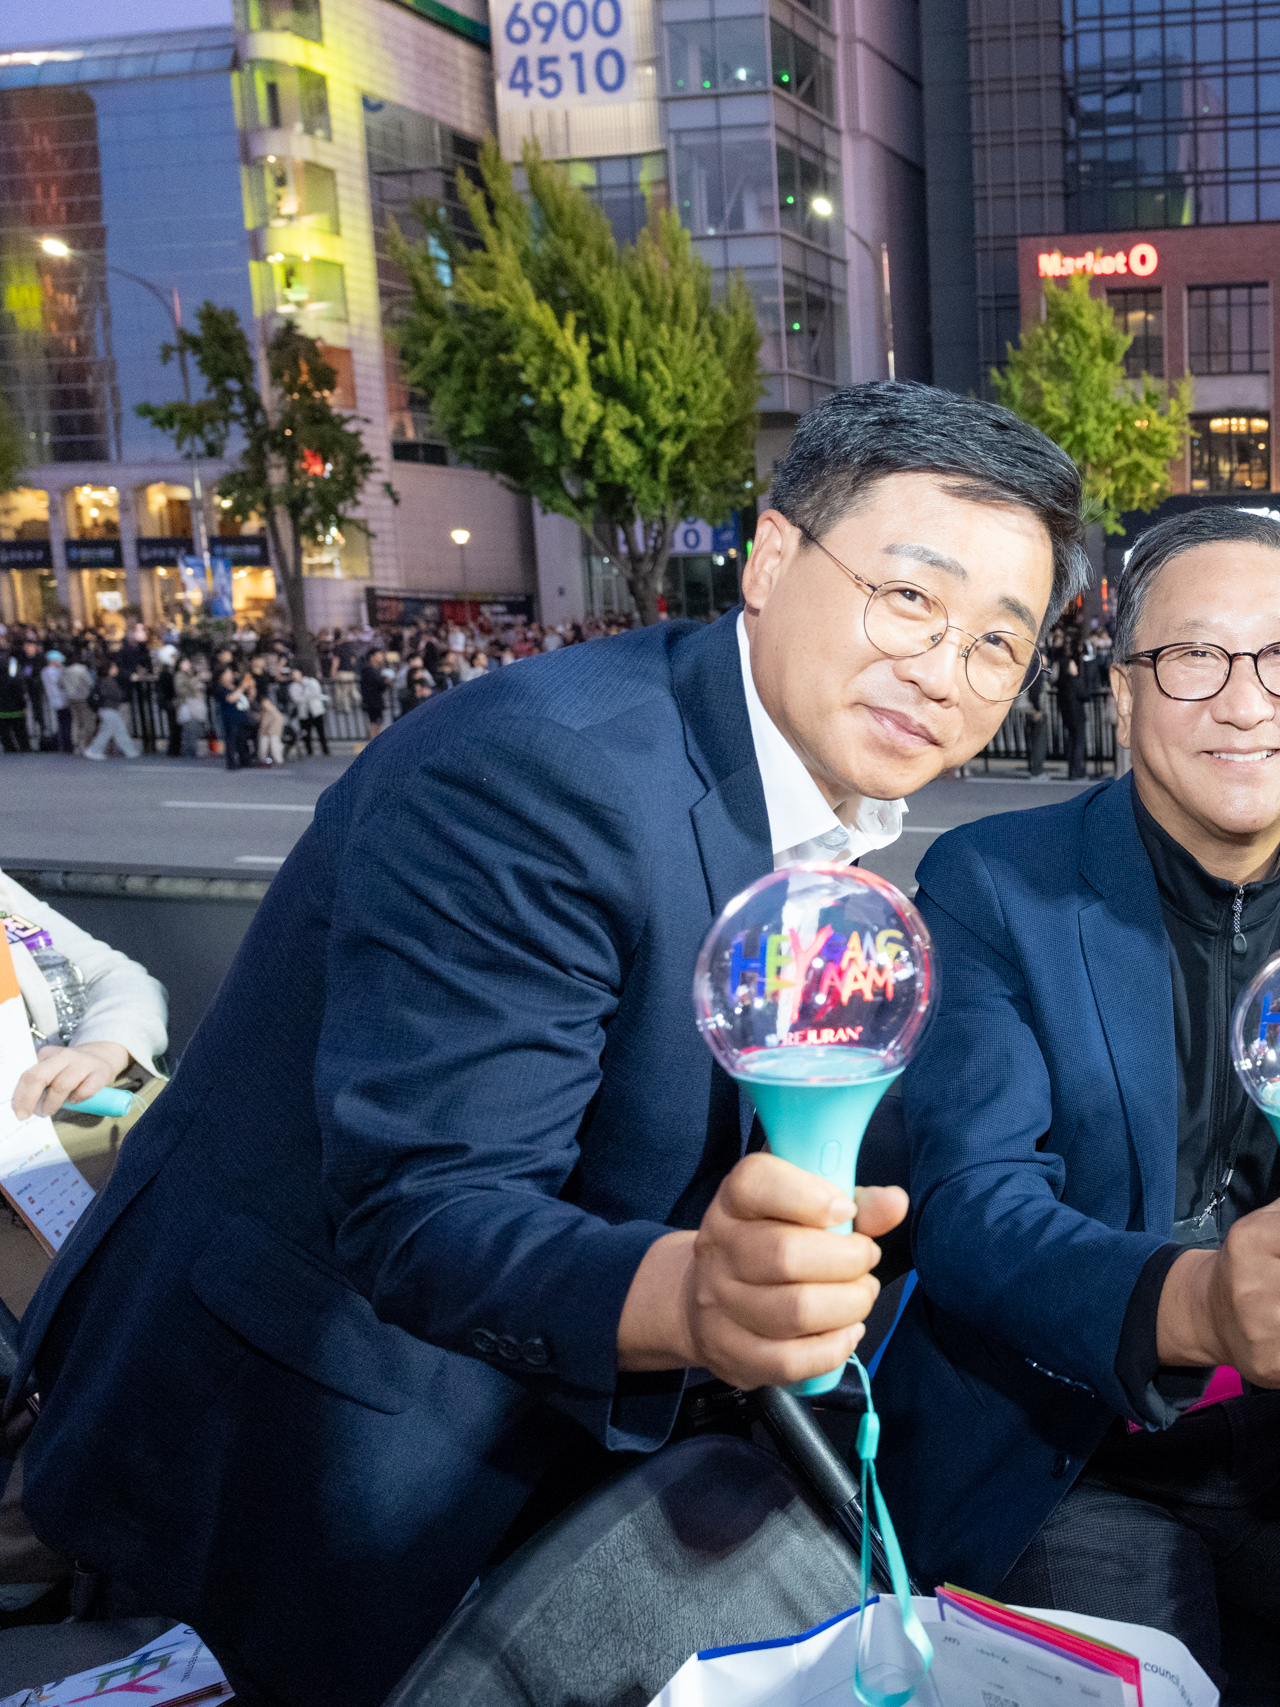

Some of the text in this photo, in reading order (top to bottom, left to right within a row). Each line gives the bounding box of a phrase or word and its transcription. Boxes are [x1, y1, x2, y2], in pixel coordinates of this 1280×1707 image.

[505, 0, 621, 45] 6900
[509, 48, 625, 99] 4510
[1038, 242, 1158, 277] Market O
